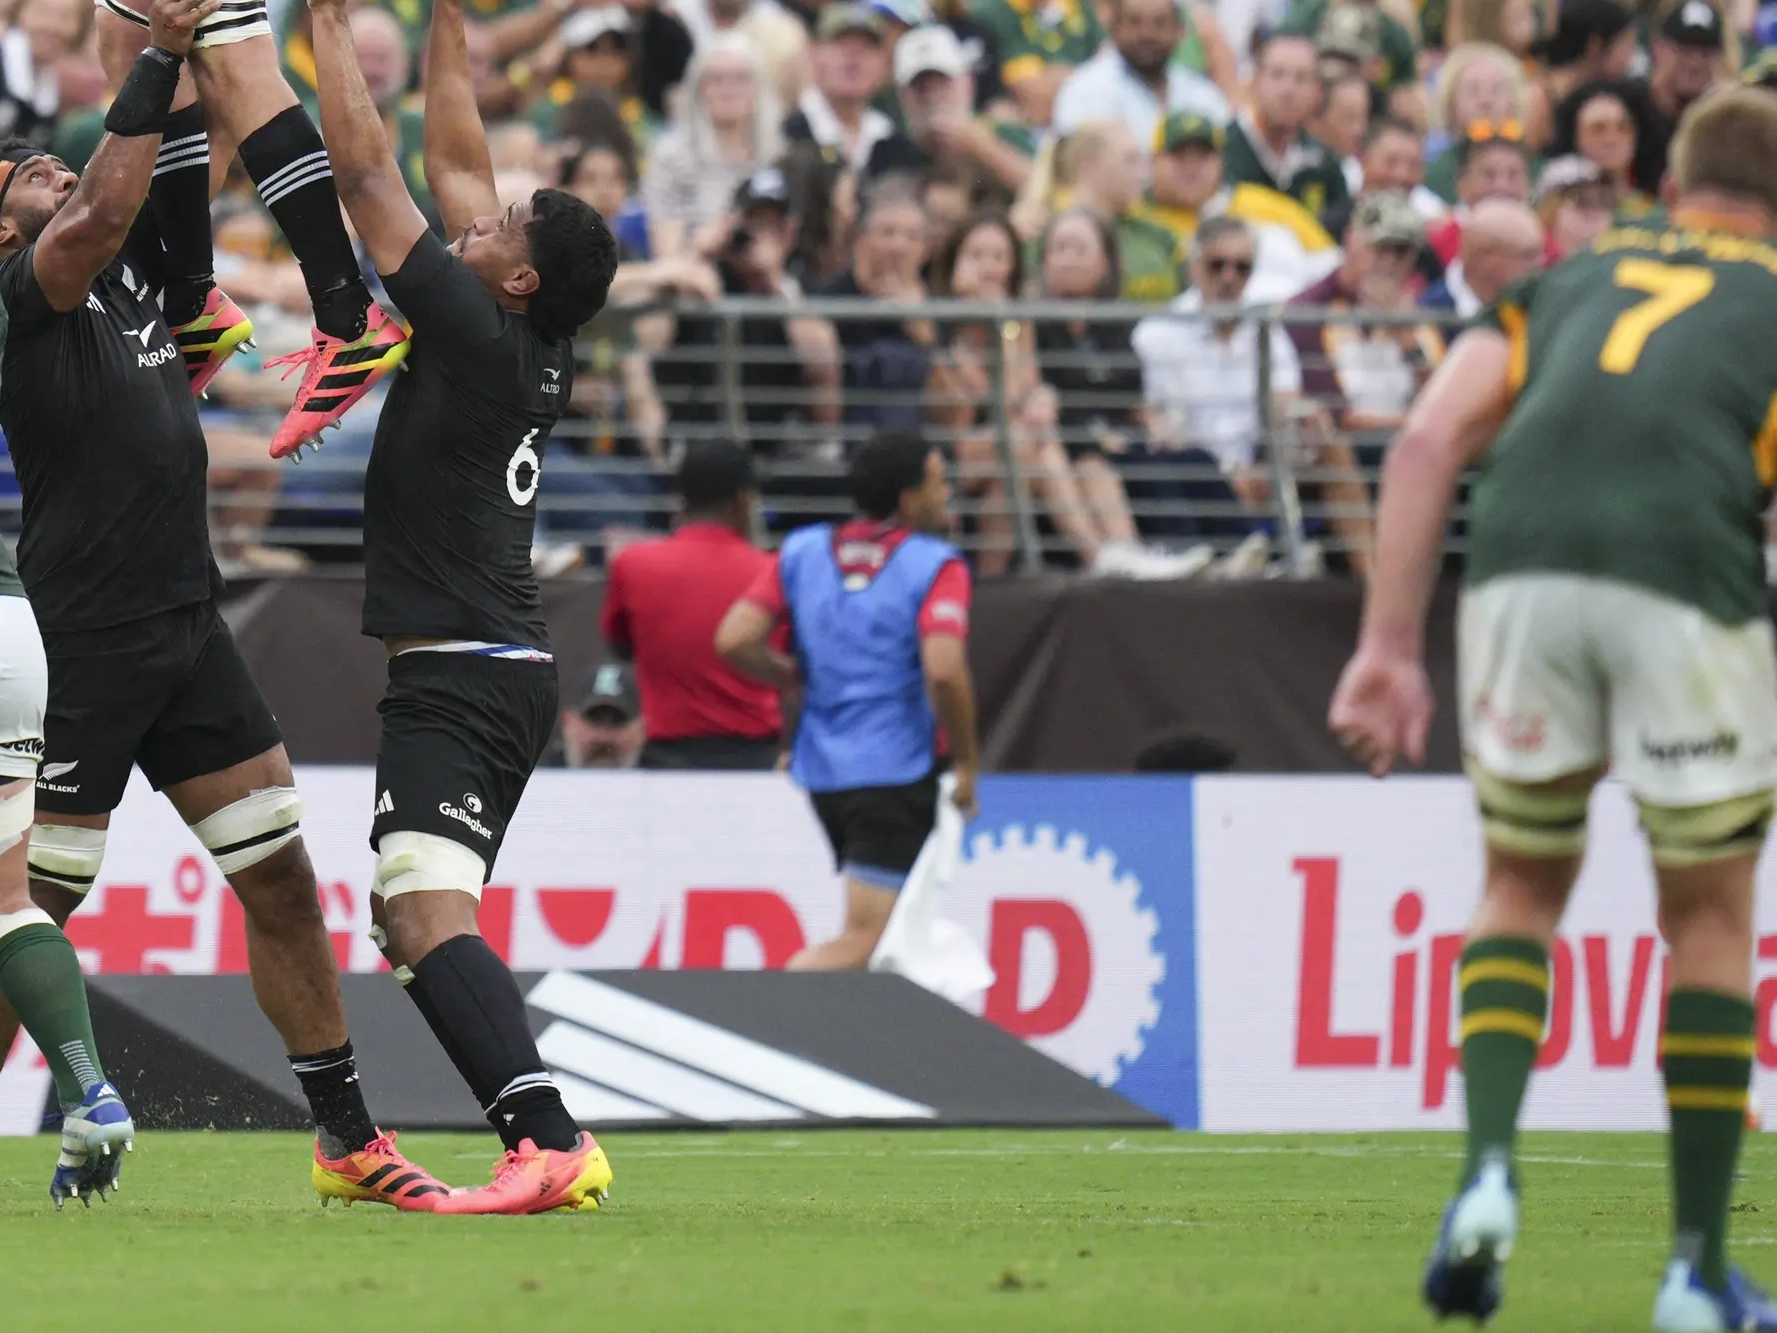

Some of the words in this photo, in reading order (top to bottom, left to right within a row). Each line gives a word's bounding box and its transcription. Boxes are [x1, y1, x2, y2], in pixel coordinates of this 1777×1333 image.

[1599, 255, 1716, 375] 7
[137, 343, 177, 368] ALRAD
[506, 428, 541, 506] 6
[439, 802, 492, 840] Gallagher
[985, 898, 1092, 1037] D
